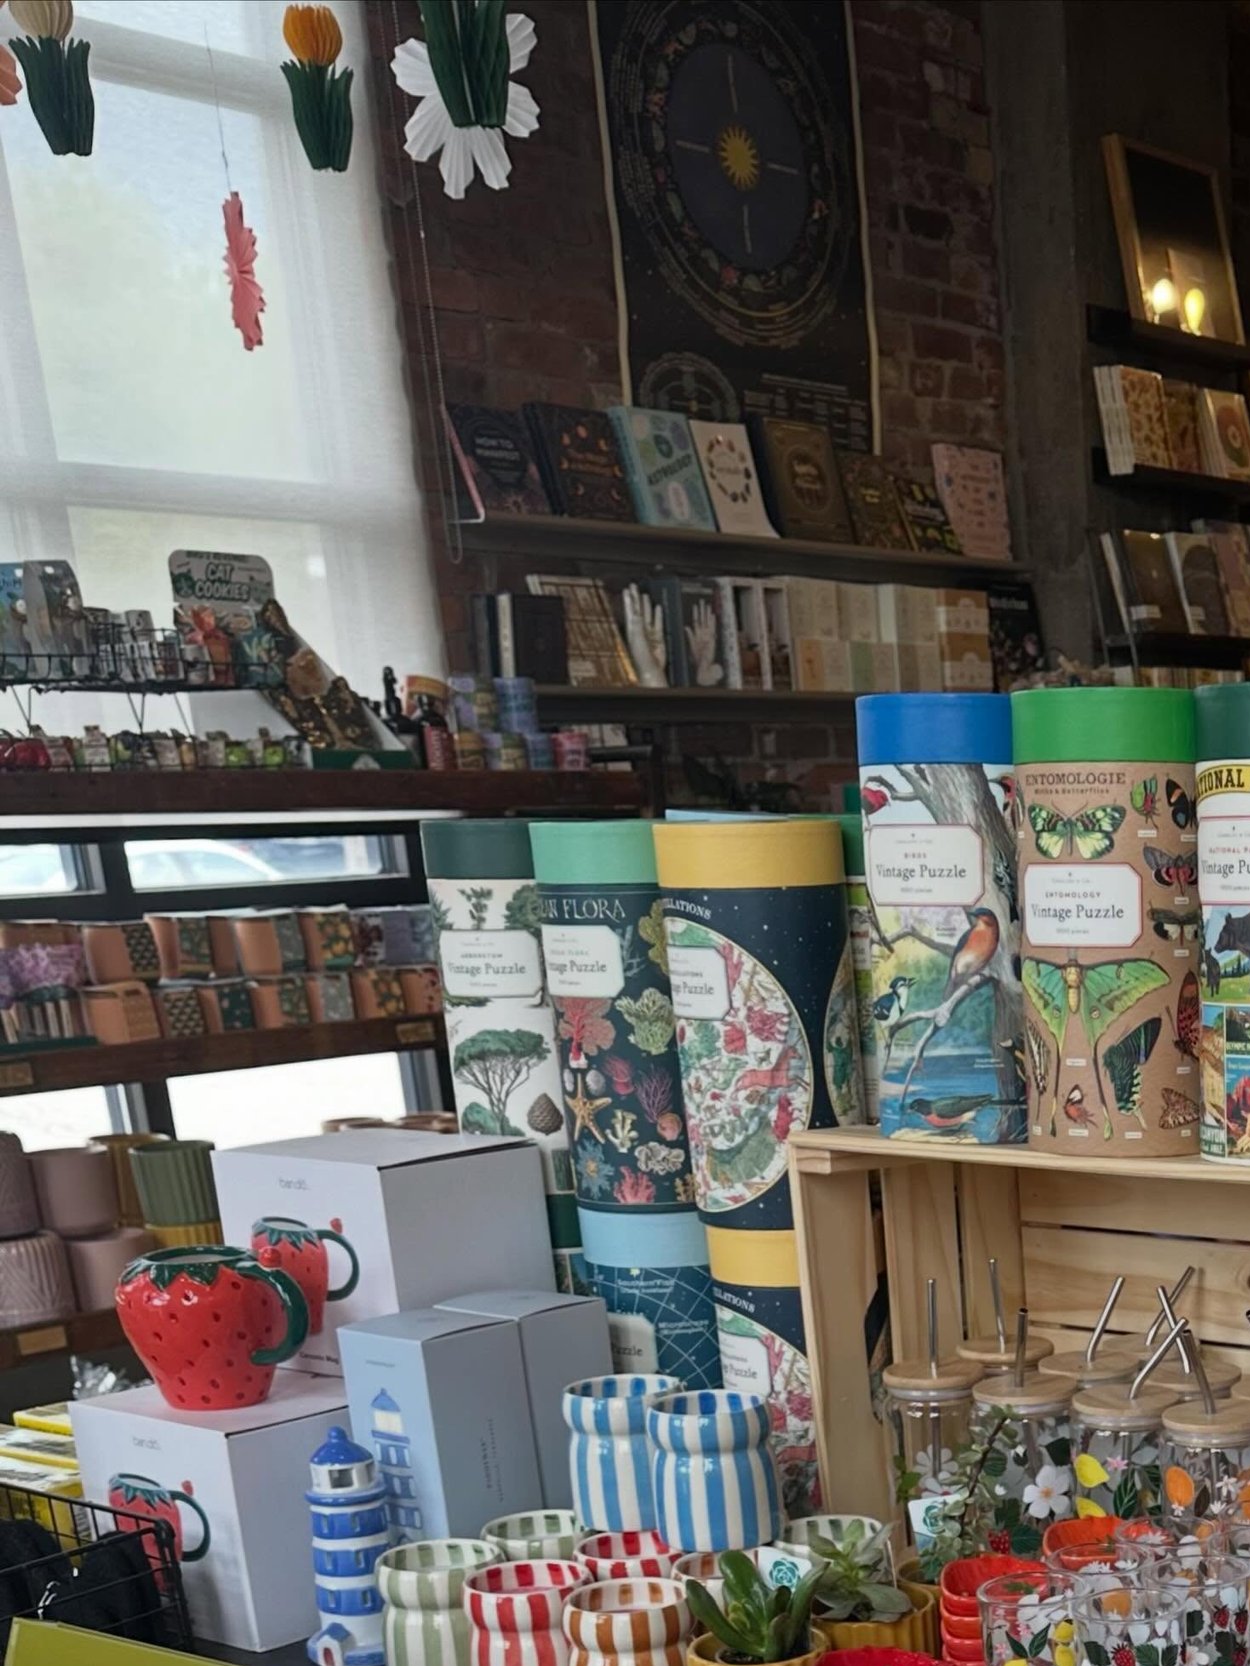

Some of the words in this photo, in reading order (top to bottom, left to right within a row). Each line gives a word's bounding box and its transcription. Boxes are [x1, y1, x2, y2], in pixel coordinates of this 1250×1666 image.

[205, 562, 234, 581] CAT
[194, 580, 251, 601] COOKIES
[1026, 772, 1126, 786] ENTOMOLOGIE
[876, 864, 916, 879] Vintage
[919, 863, 967, 878] Puzzle
[1201, 860, 1234, 879] Vintage
[563, 899, 626, 922] FLORA
[1031, 904, 1072, 922] Vintage
[1076, 904, 1124, 919] Puzzle
[447, 962, 481, 977] Vintage
[484, 962, 527, 975] Puzzle
[569, 961, 607, 973] Puzzle
[682, 983, 714, 996] Puzzle
[613, 1343, 643, 1357] uzzle
[731, 1364, 758, 1379] Puzzle
